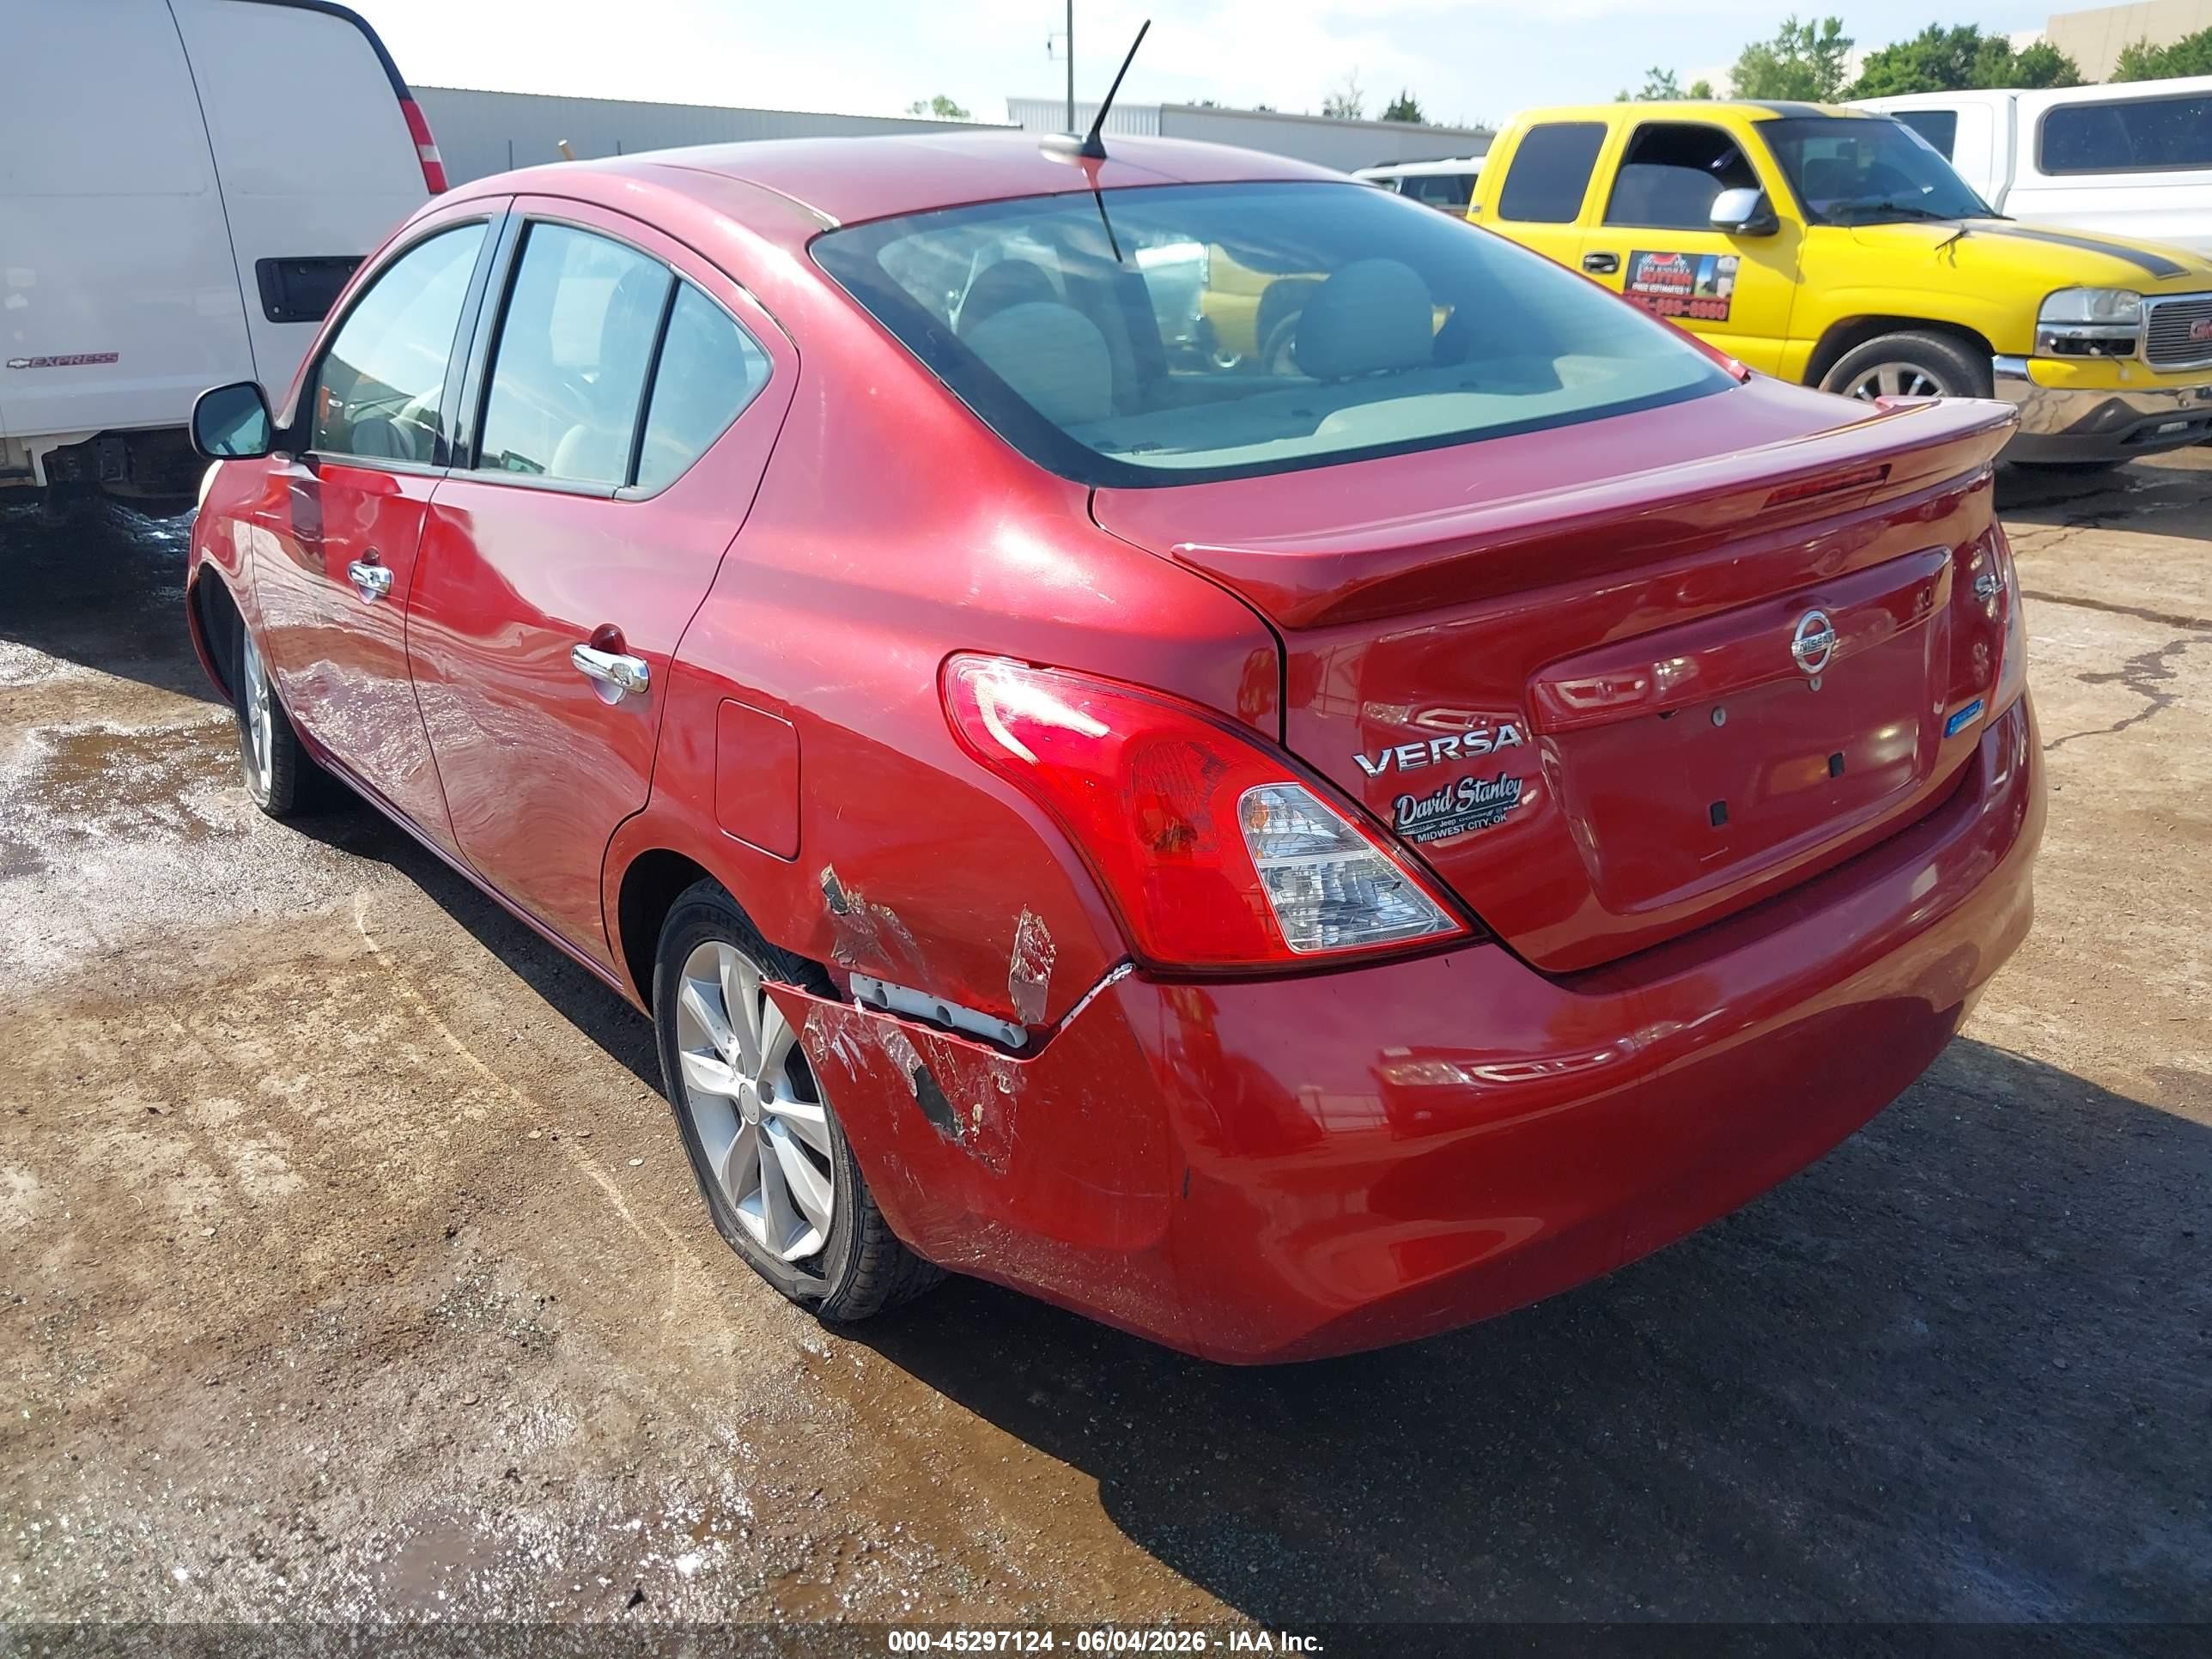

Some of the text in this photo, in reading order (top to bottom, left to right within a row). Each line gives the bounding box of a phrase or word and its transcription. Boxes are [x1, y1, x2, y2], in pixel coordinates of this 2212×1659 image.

[30, 352, 118, 368] EXPRESS
[1975, 572, 2004, 602] SL
[1798, 632, 1833, 654] NISSAN
[1352, 724, 1525, 778] VERSA
[1396, 773, 1523, 825] David Stanley
[1417, 824, 1465, 844] MIDWEST
[1468, 818, 1492, 831] CITY,
[1493, 812, 1507, 823] OK
[1439, 817, 1456, 829] Jeep
